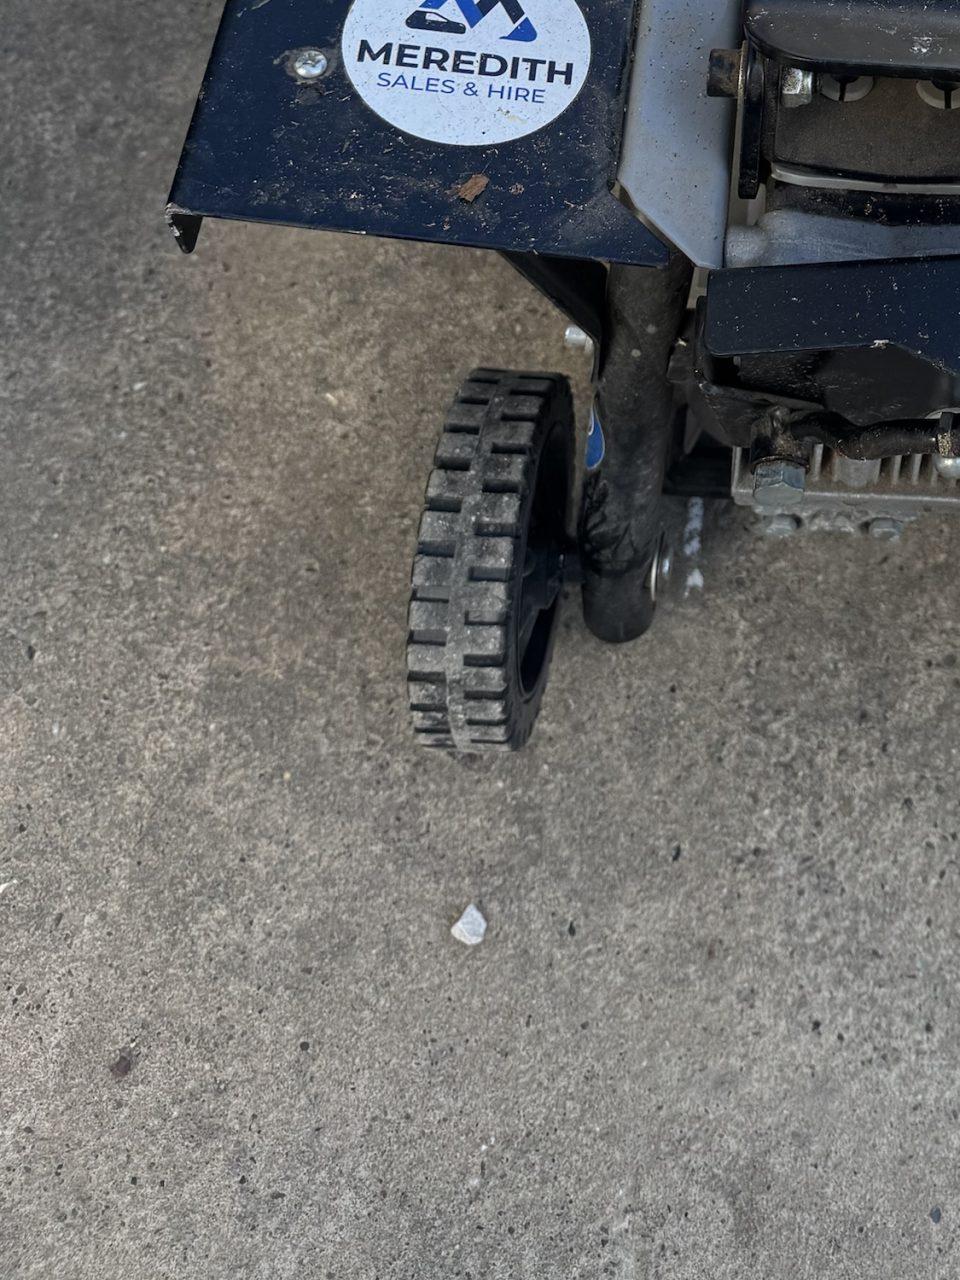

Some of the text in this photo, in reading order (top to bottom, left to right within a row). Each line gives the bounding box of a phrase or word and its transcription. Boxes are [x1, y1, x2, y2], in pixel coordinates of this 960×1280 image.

[357, 39, 573, 85] MEREDITH
[377, 72, 546, 103] SALES & HIRE
